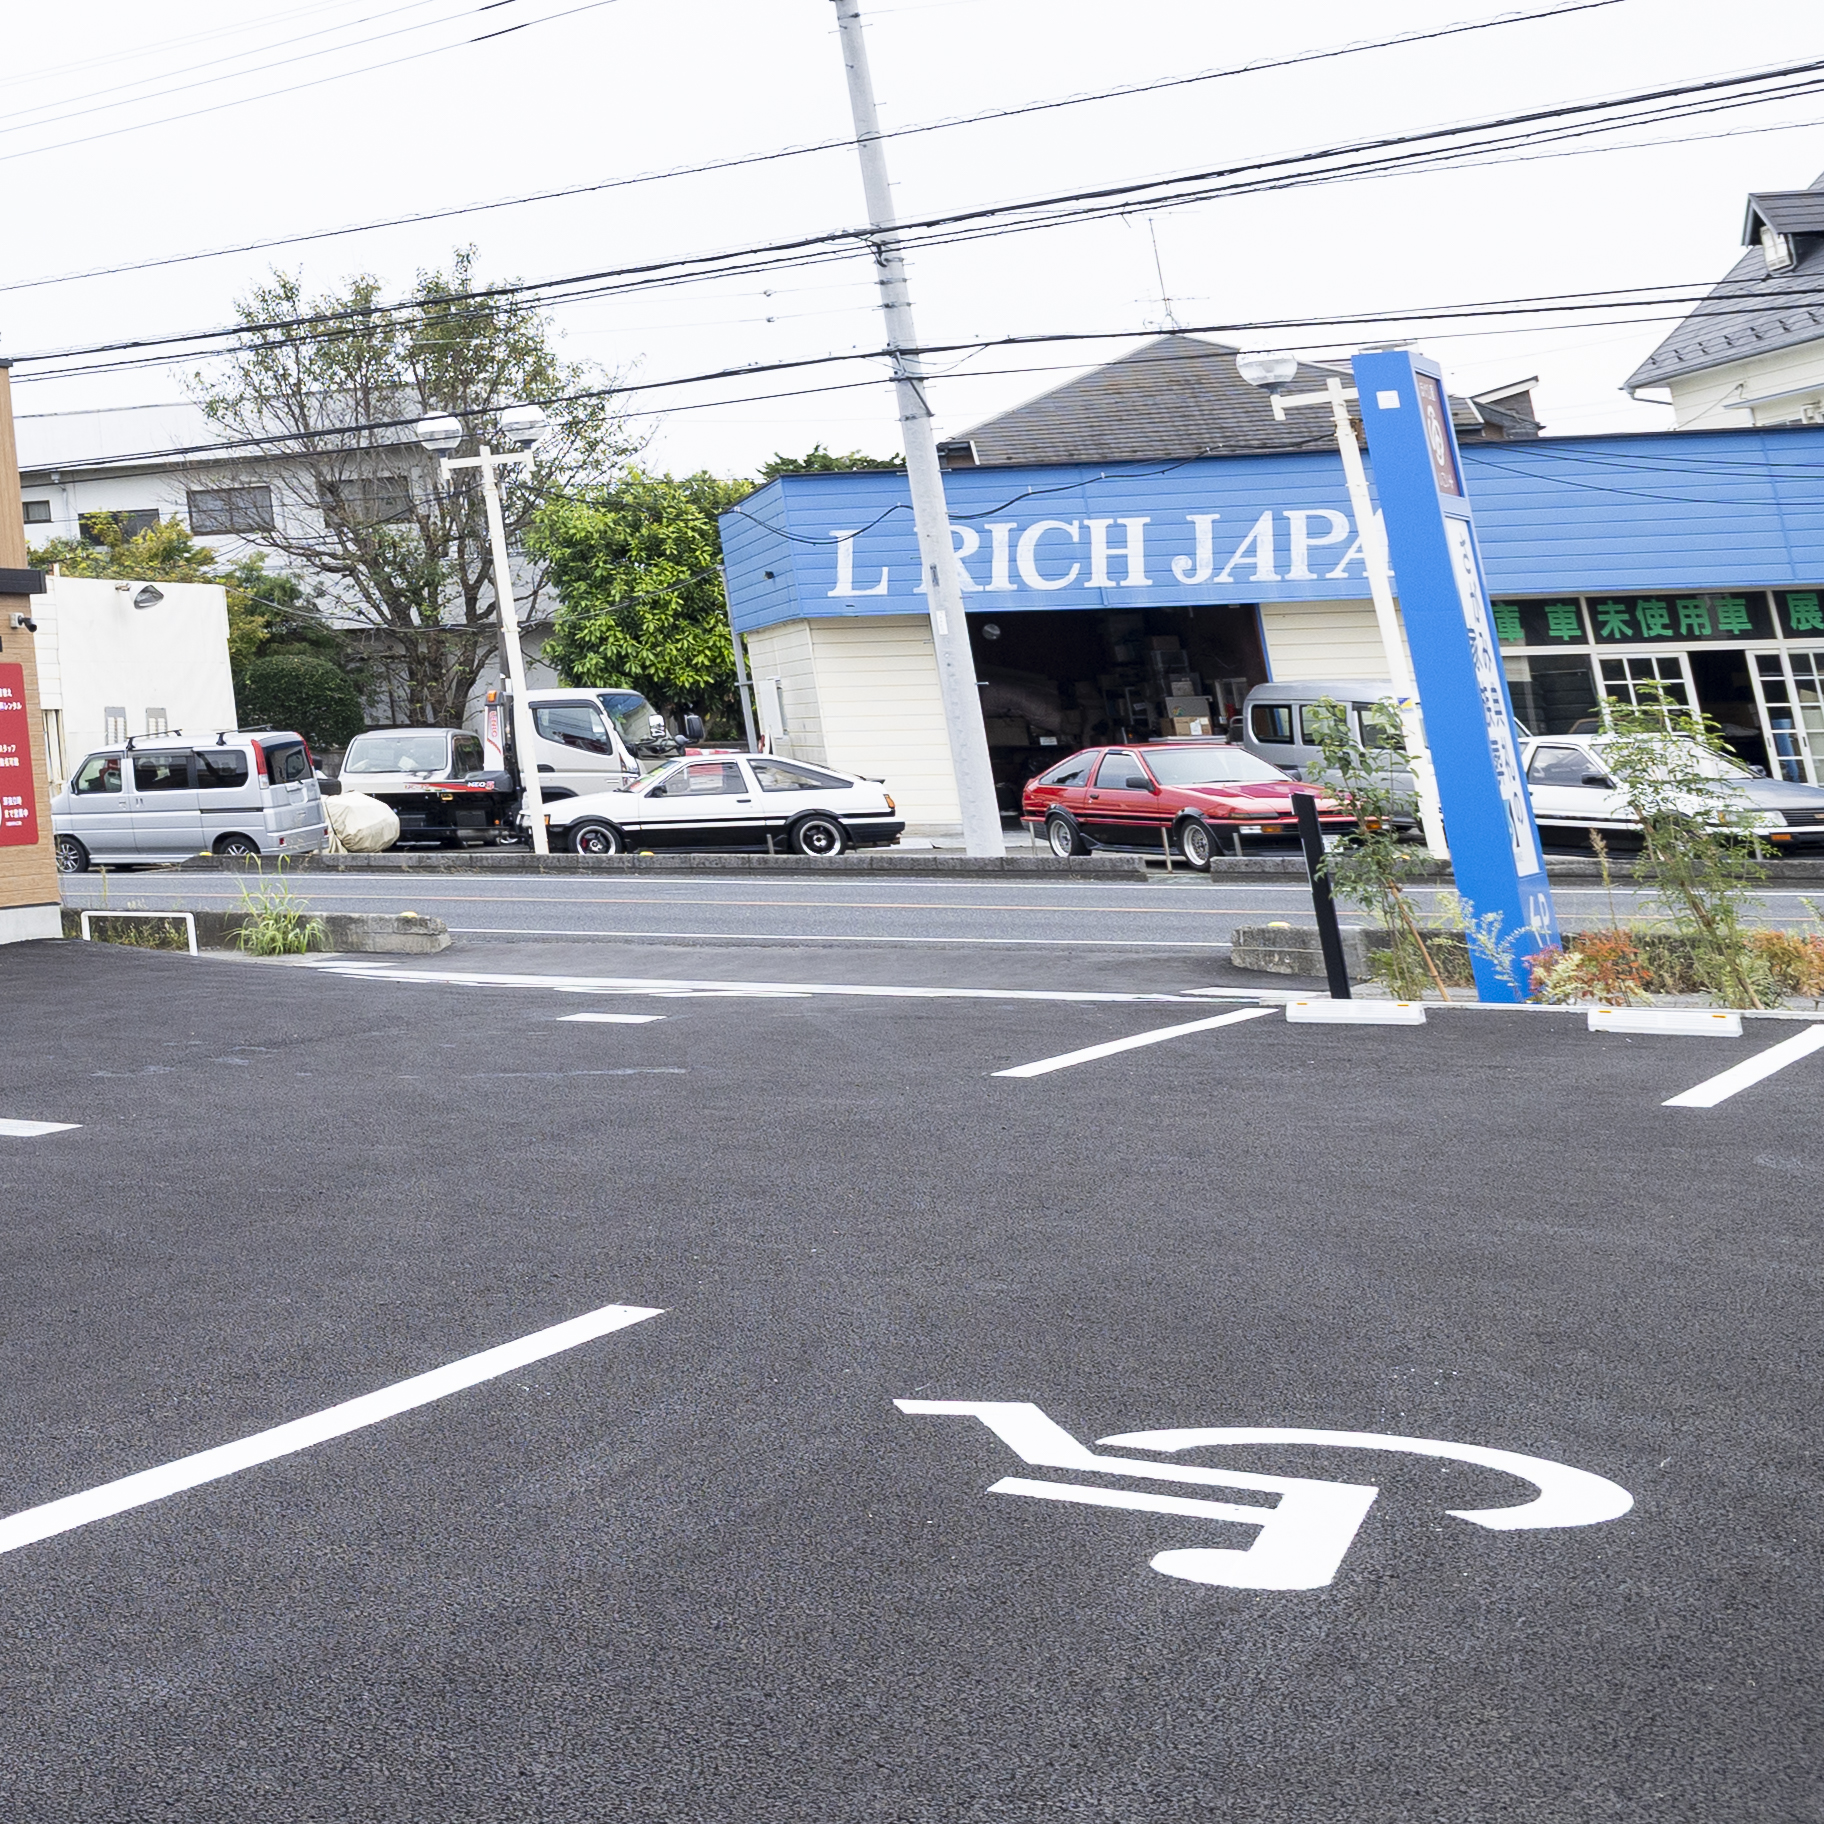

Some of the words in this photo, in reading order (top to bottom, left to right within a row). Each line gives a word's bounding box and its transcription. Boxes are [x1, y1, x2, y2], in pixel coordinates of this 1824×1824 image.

[913, 516, 1152, 593] RICH
[1170, 508, 1396, 587] JAPA
[1596, 598, 1753, 640] 未使用車
